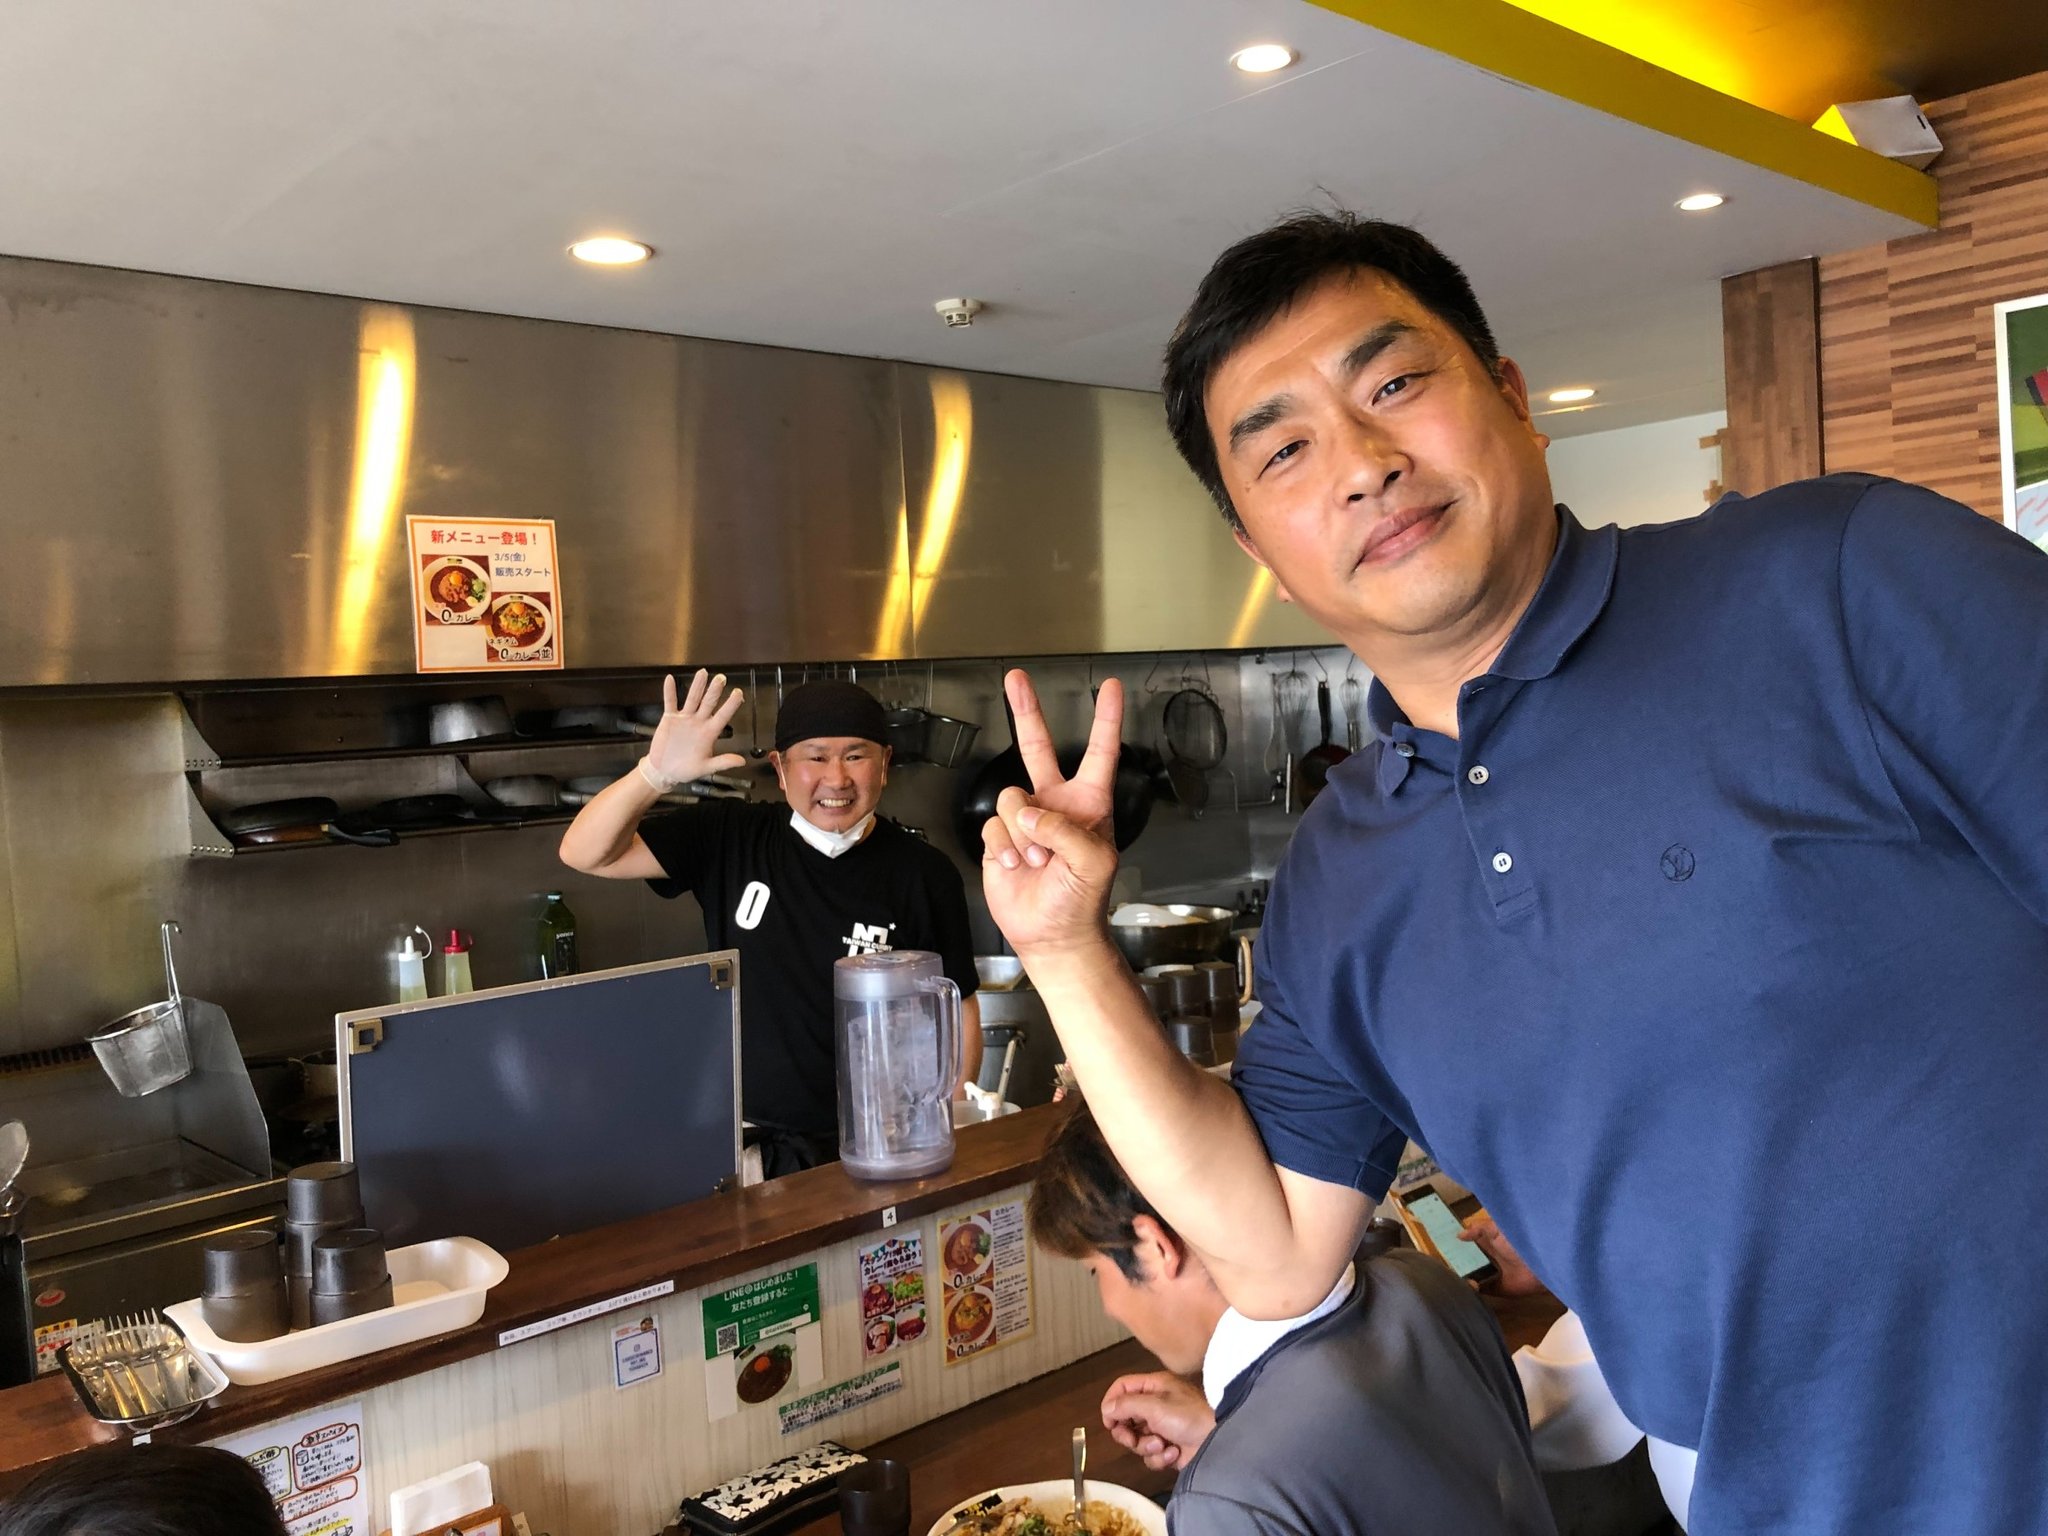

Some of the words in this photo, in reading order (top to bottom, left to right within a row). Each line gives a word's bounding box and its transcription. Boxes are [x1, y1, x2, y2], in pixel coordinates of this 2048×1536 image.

[431, 529, 537, 545] 新メニュー登場！
[494, 553, 526, 563] 3/5(金)
[495, 567, 551, 577] 販売スタート
[842, 936, 871, 949] TAIWAN
[871, 943, 893, 952] CURRY
[887, 1214, 894, 1222] 4
